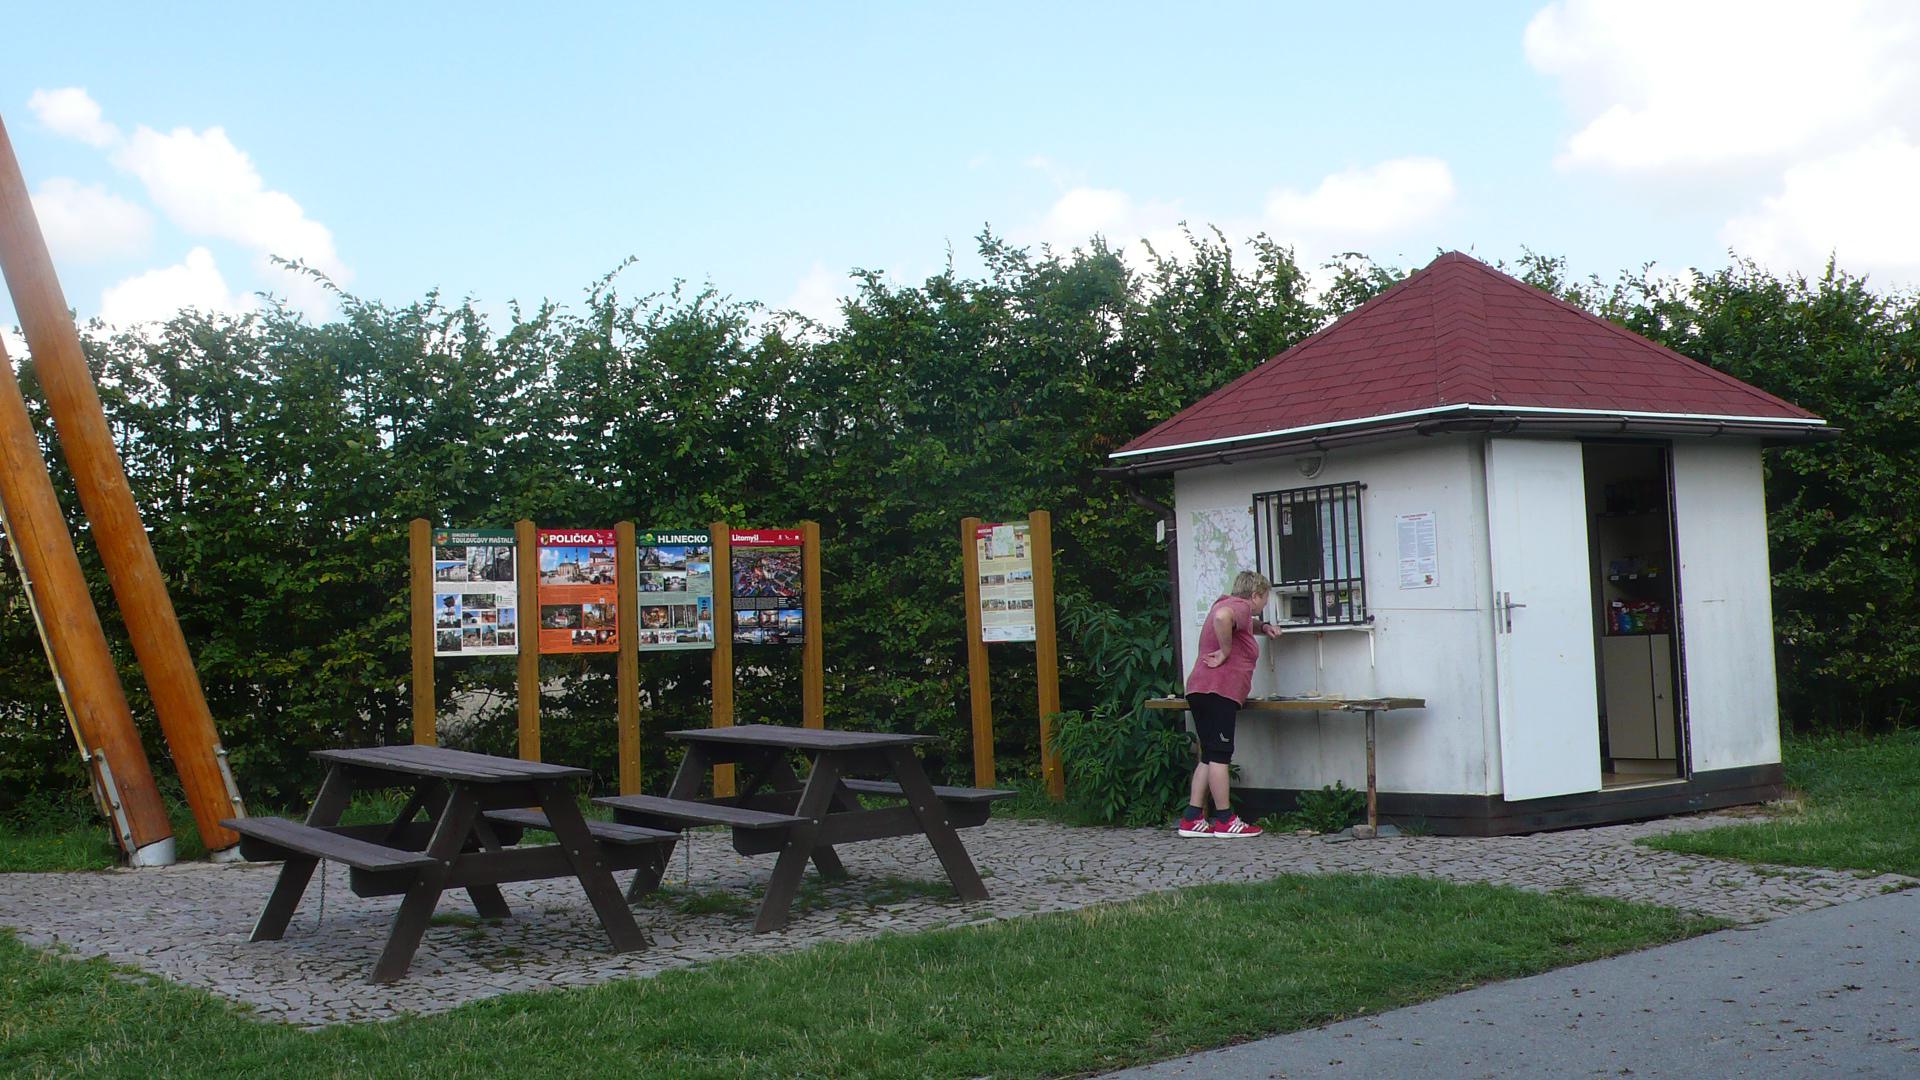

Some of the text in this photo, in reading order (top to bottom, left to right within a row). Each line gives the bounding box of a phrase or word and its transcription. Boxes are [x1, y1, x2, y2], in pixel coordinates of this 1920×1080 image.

[549, 533, 595, 543] POLIČKA
[657, 535, 708, 543] HLINECKO
[732, 534, 759, 543] Litomyšl
